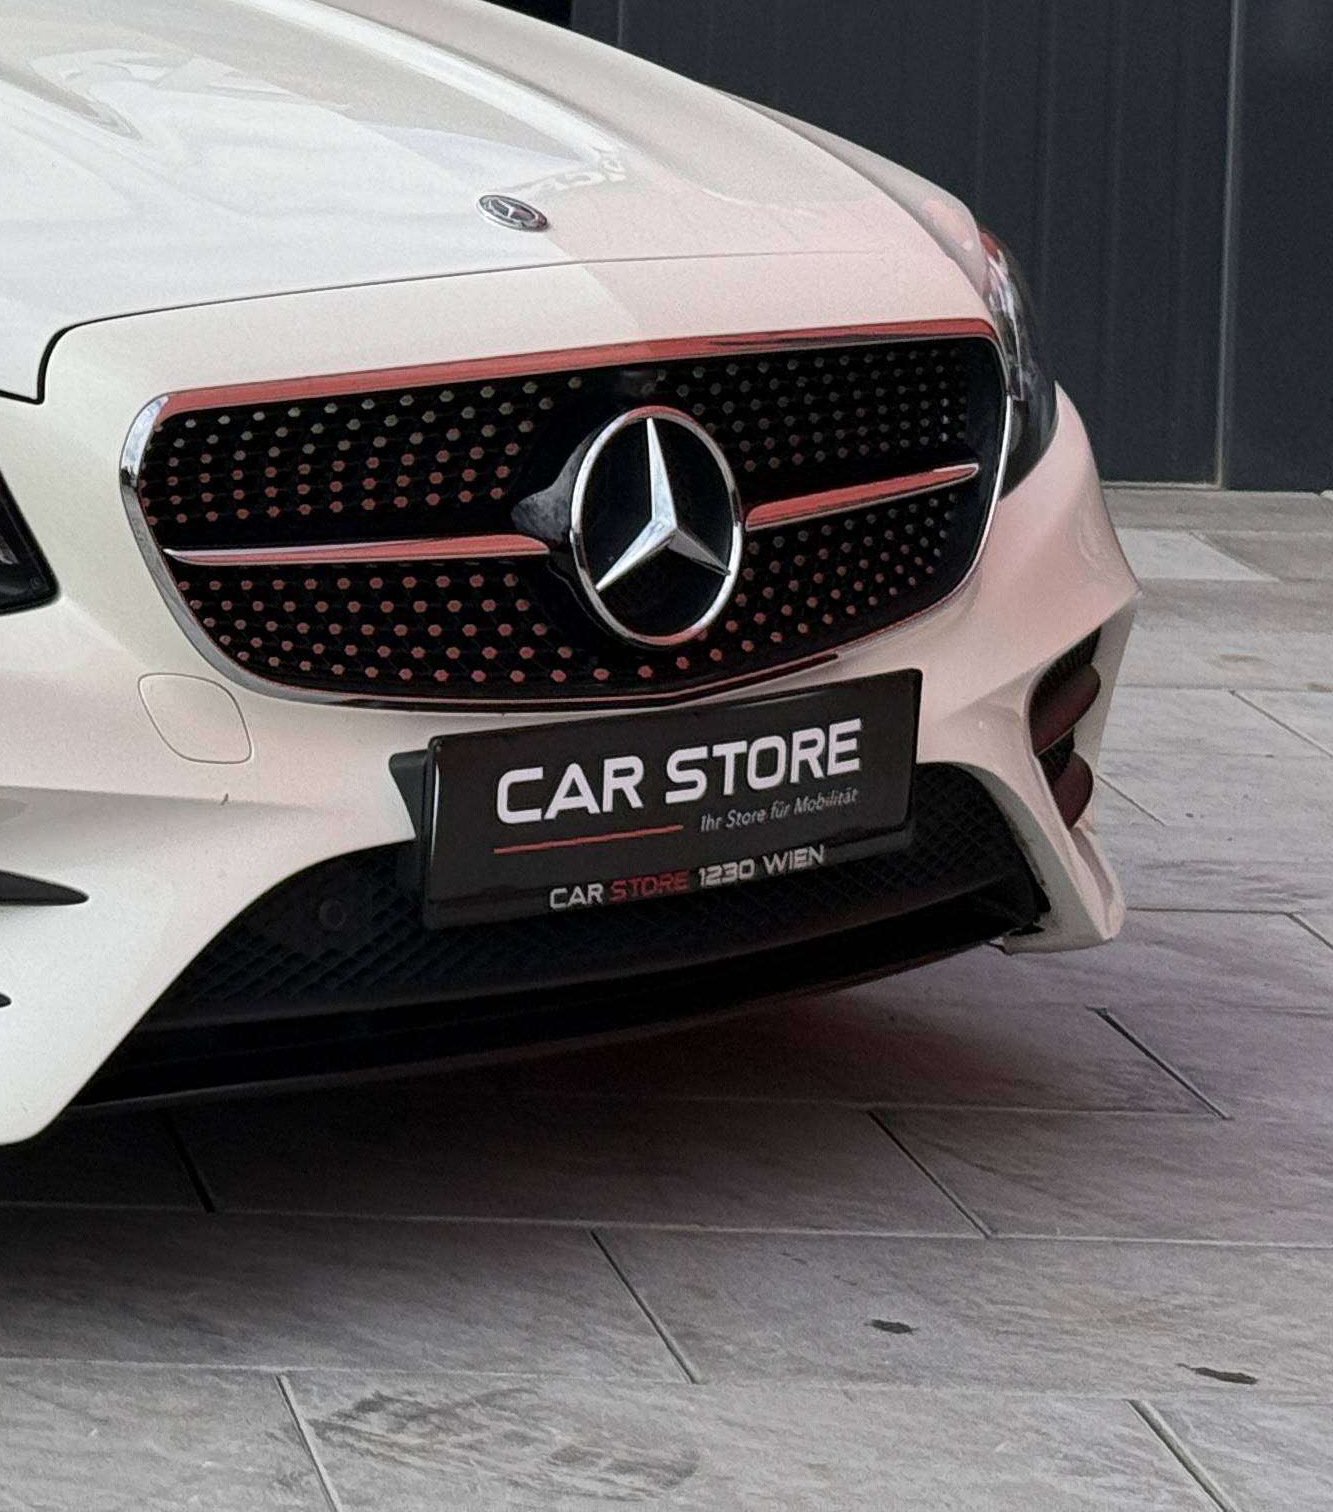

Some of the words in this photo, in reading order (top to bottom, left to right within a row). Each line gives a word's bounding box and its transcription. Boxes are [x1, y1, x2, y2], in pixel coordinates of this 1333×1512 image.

[496, 755, 645, 824] CAR
[665, 718, 862, 804] STORE
[700, 814, 724, 833] Ihr
[725, 808, 766, 829] Store
[770, 800, 791, 820] für
[793, 786, 859, 815] Mobilität
[549, 883, 604, 910] CAR
[609, 870, 690, 903] STORE
[697, 858, 756, 887] 1230
[762, 843, 826, 875] WIEN
